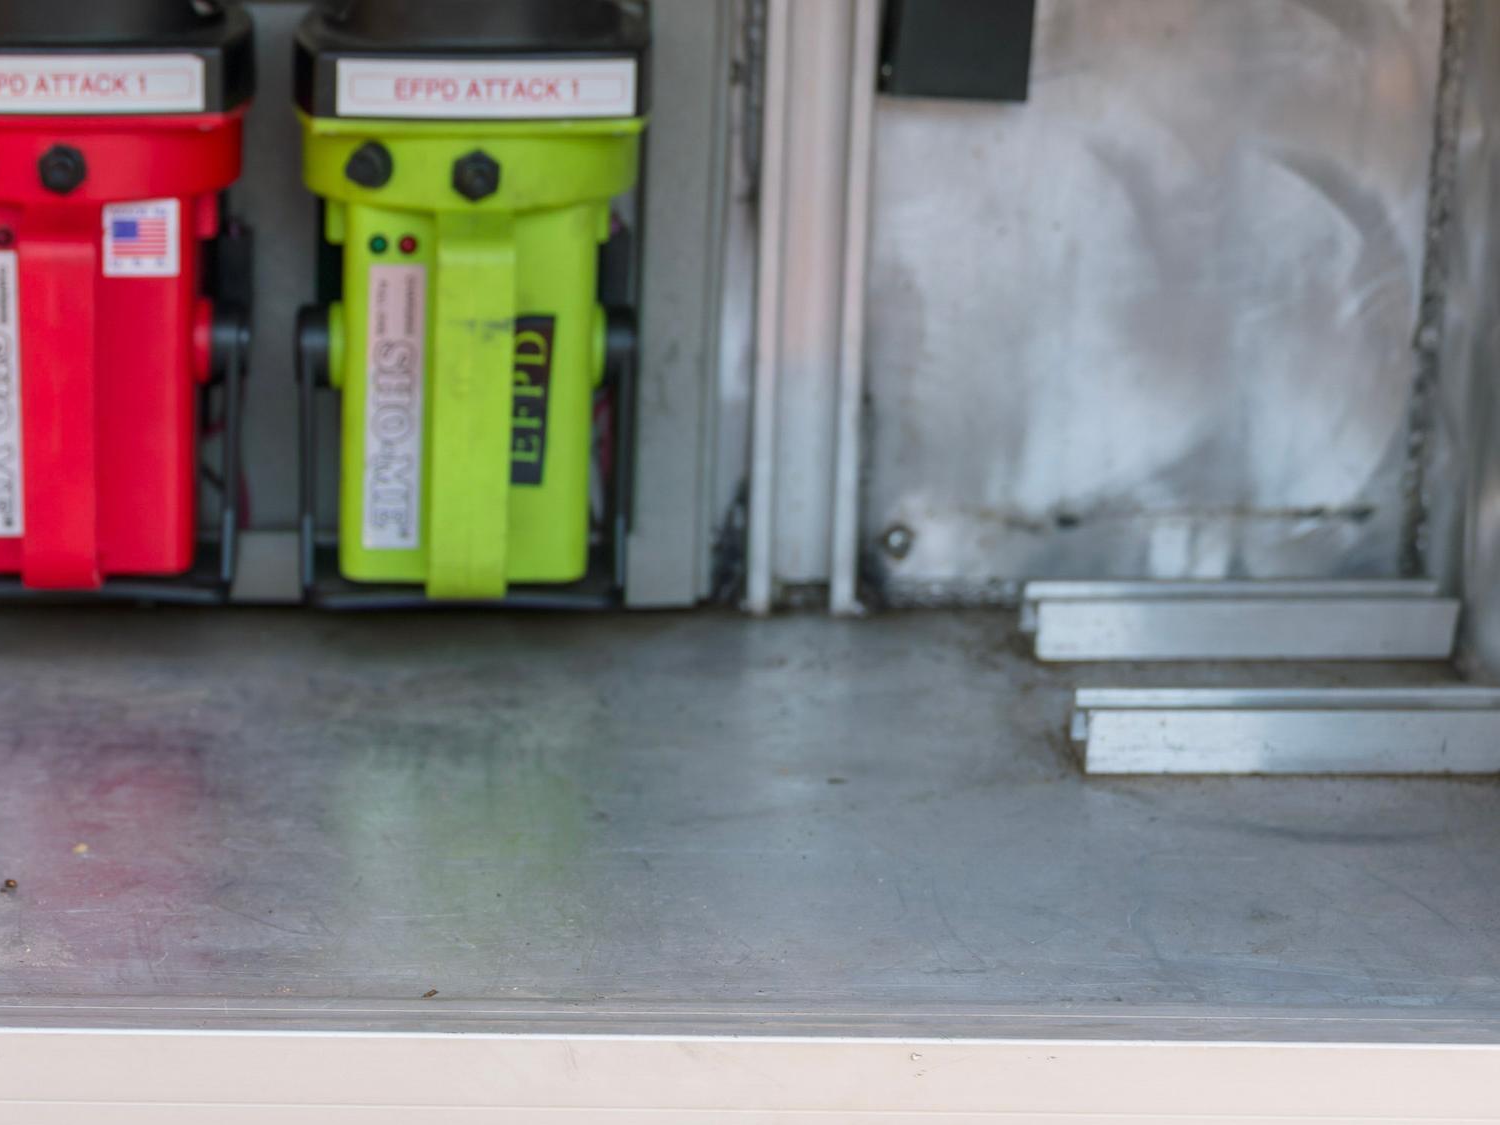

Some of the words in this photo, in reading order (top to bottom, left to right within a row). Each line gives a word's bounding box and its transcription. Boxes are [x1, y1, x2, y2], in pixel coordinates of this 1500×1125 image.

[34, 73, 127, 96] ATTACK
[137, 73, 148, 95] 1
[394, 78, 460, 101] EFPD
[467, 78, 562, 100] ATTACK
[570, 78, 580, 99] 1
[512, 330, 547, 464] EFPD
